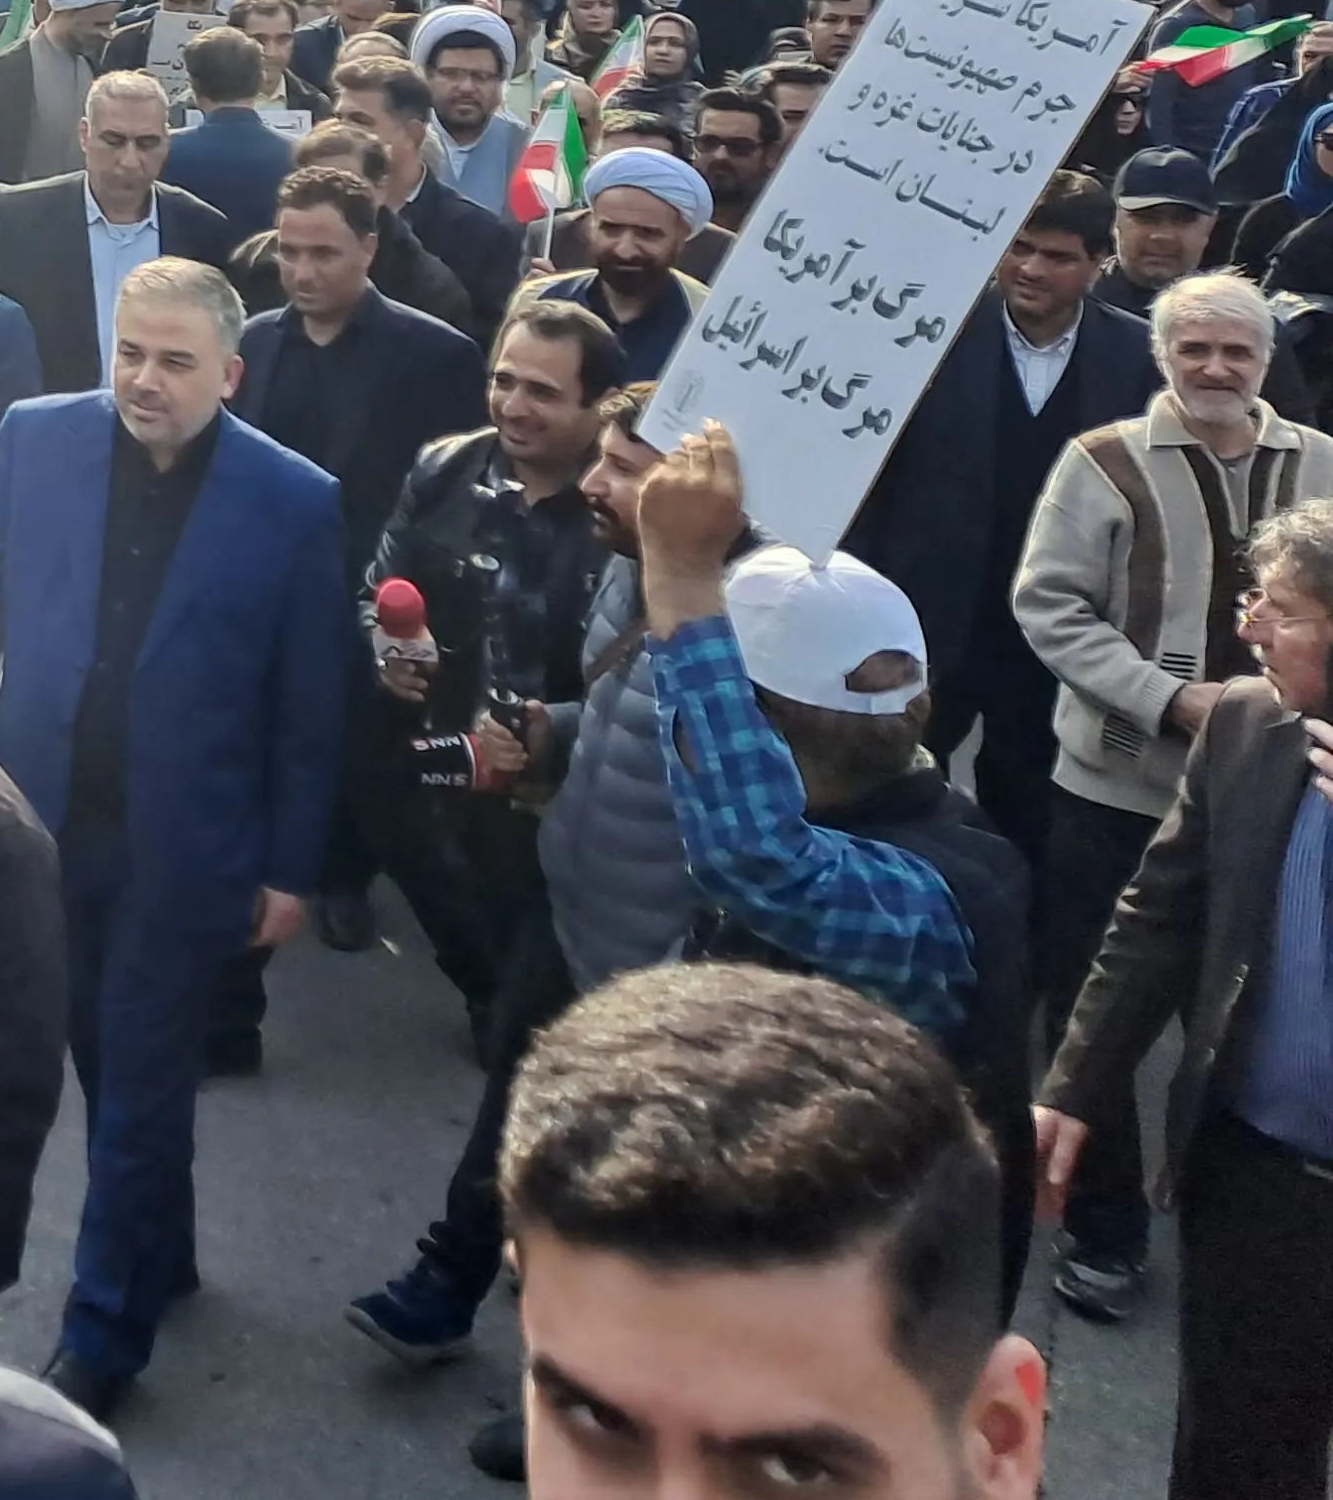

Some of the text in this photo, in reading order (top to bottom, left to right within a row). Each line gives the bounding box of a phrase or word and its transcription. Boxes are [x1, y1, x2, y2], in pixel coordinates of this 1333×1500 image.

[847, 83, 1034, 175] در جنایات غزه و
[1011, 80, 1077, 125] جرم
[895, 172, 1008, 242] لبنان
[763, 208, 948, 349] مرگ بر آمریکا
[701, 294, 894, 440] مرگ بر اسرائیل
